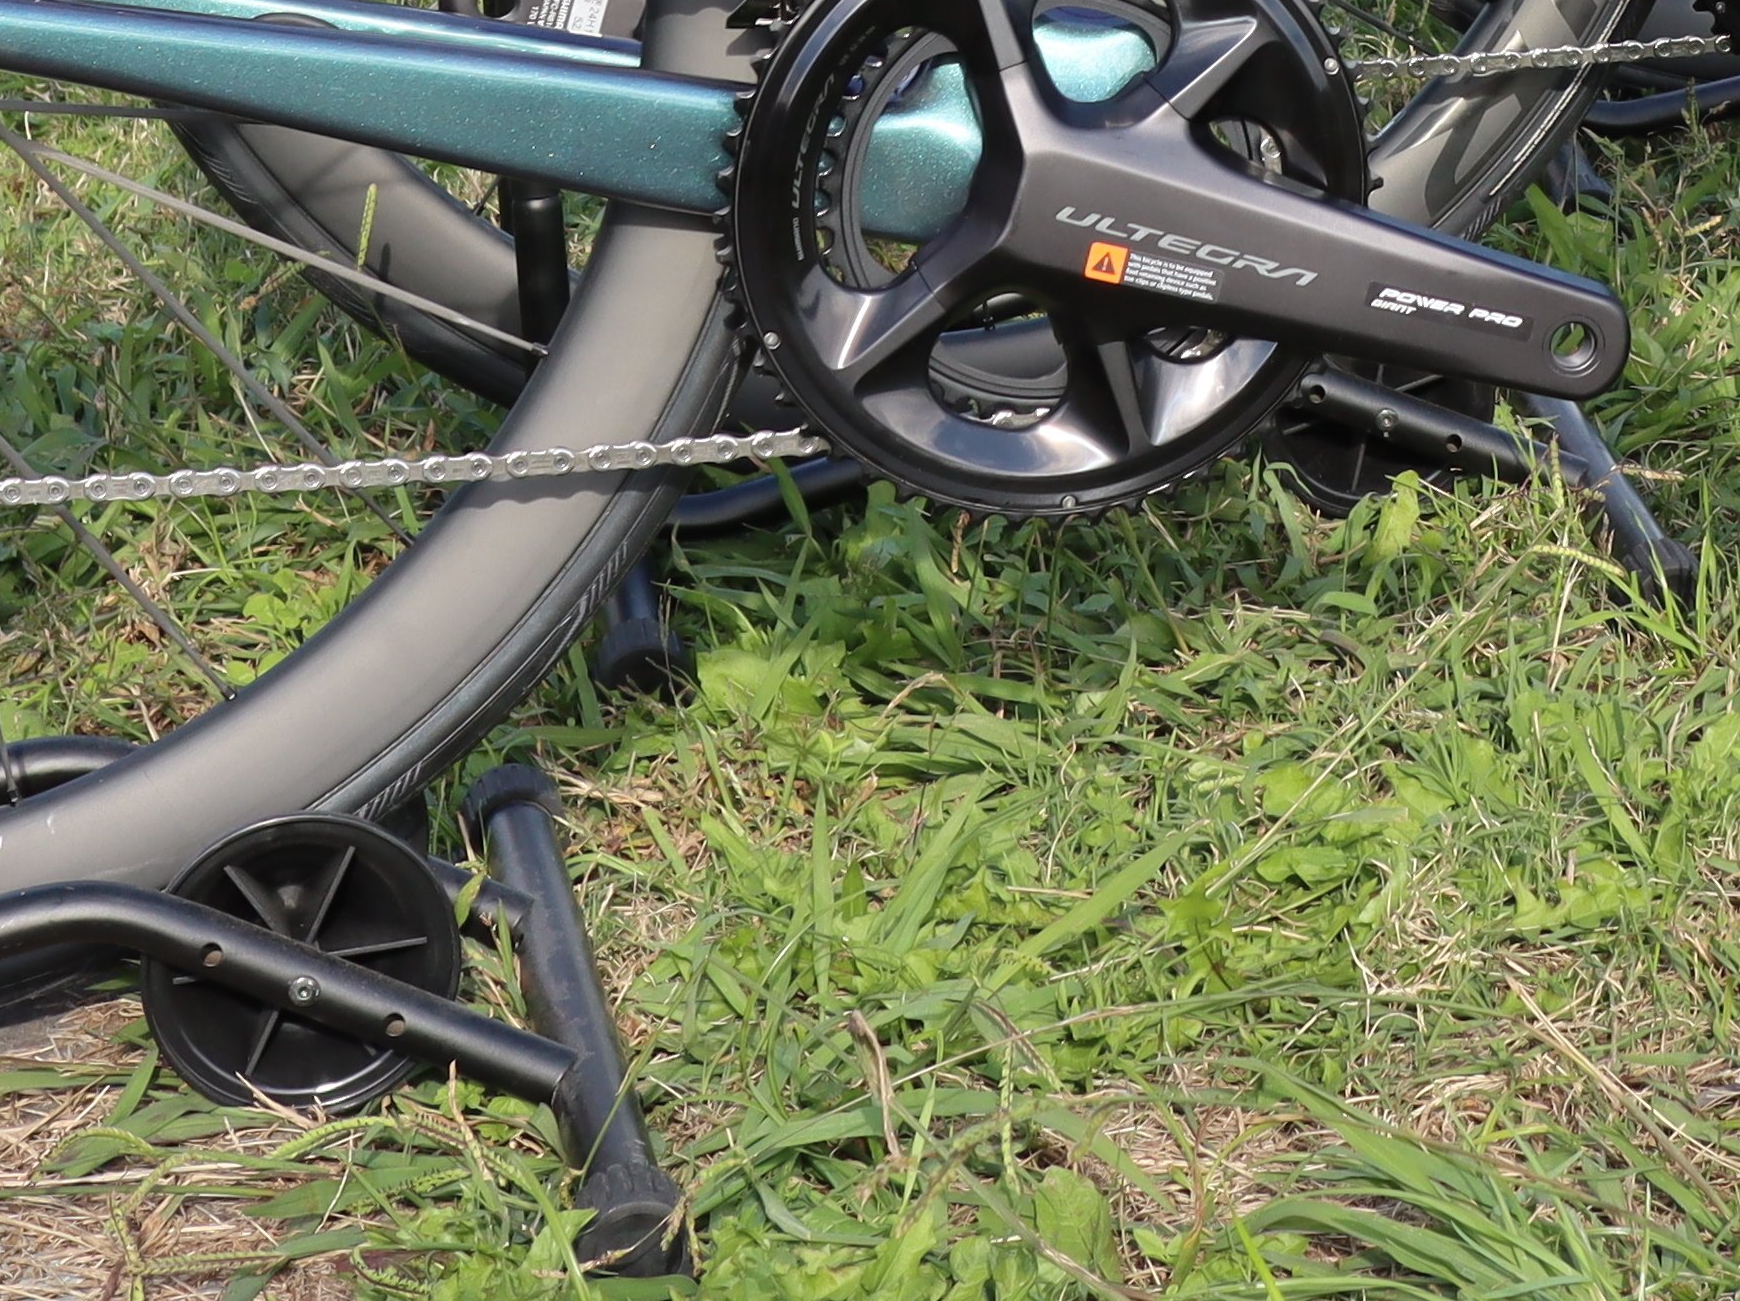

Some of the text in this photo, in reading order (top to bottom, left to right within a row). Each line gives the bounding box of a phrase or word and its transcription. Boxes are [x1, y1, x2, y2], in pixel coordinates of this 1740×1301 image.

[791, 72, 836, 210] ULTEGRA
[1055, 205, 1319, 287] ULTEGRA
[1370, 298, 1417, 315] GIANT
[1378, 288, 1524, 328] POWER PRO
